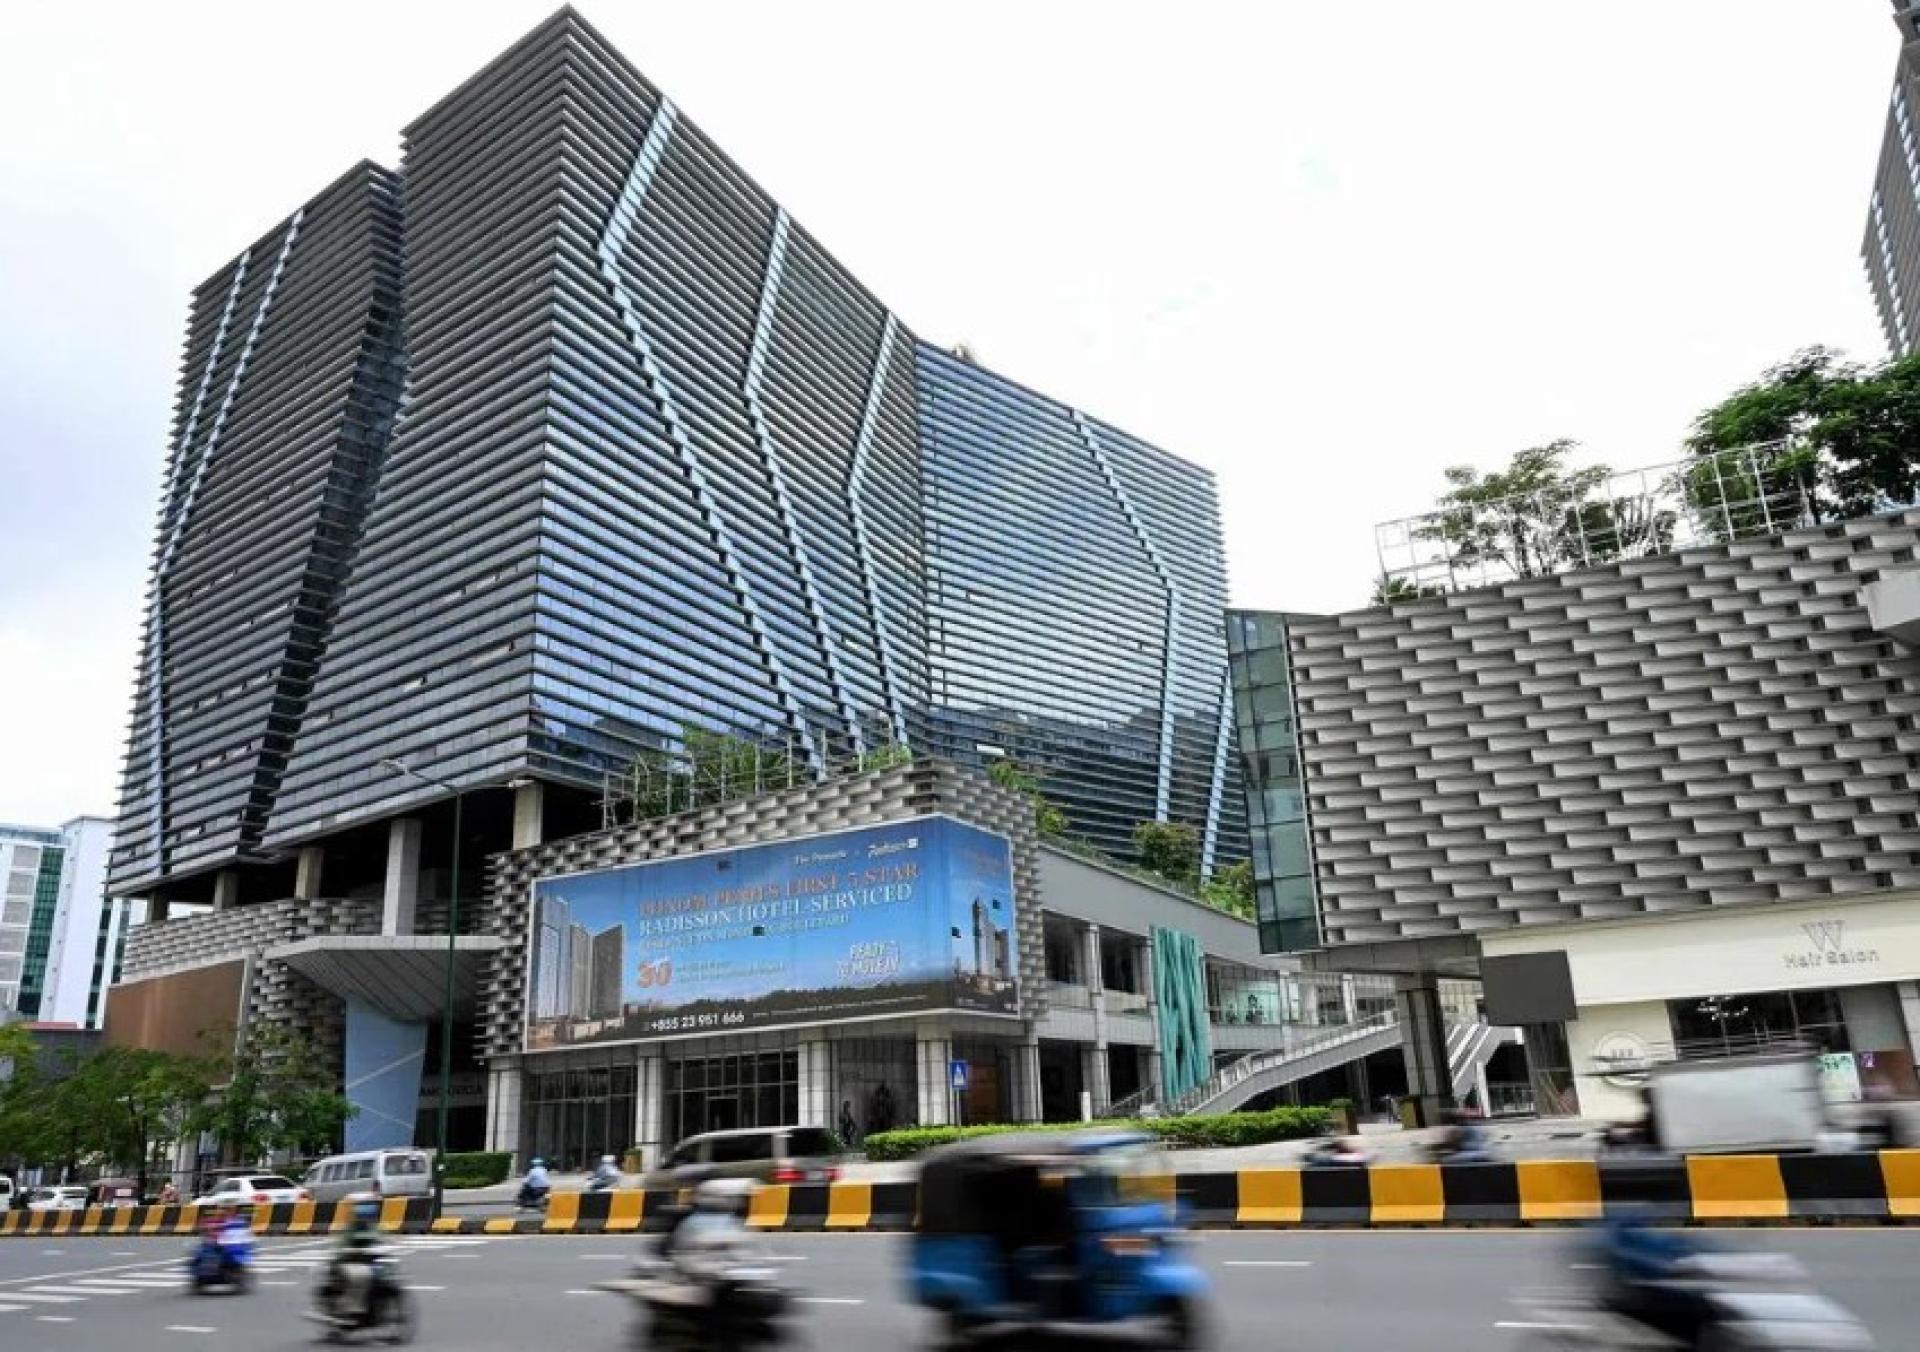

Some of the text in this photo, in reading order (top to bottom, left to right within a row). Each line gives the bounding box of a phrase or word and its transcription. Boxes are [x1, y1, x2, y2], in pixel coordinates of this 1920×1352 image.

[640, 909, 732, 937] RADISSON
[811, 883, 912, 912] SERVICED
[1783, 949, 1880, 969] Hair Salon
